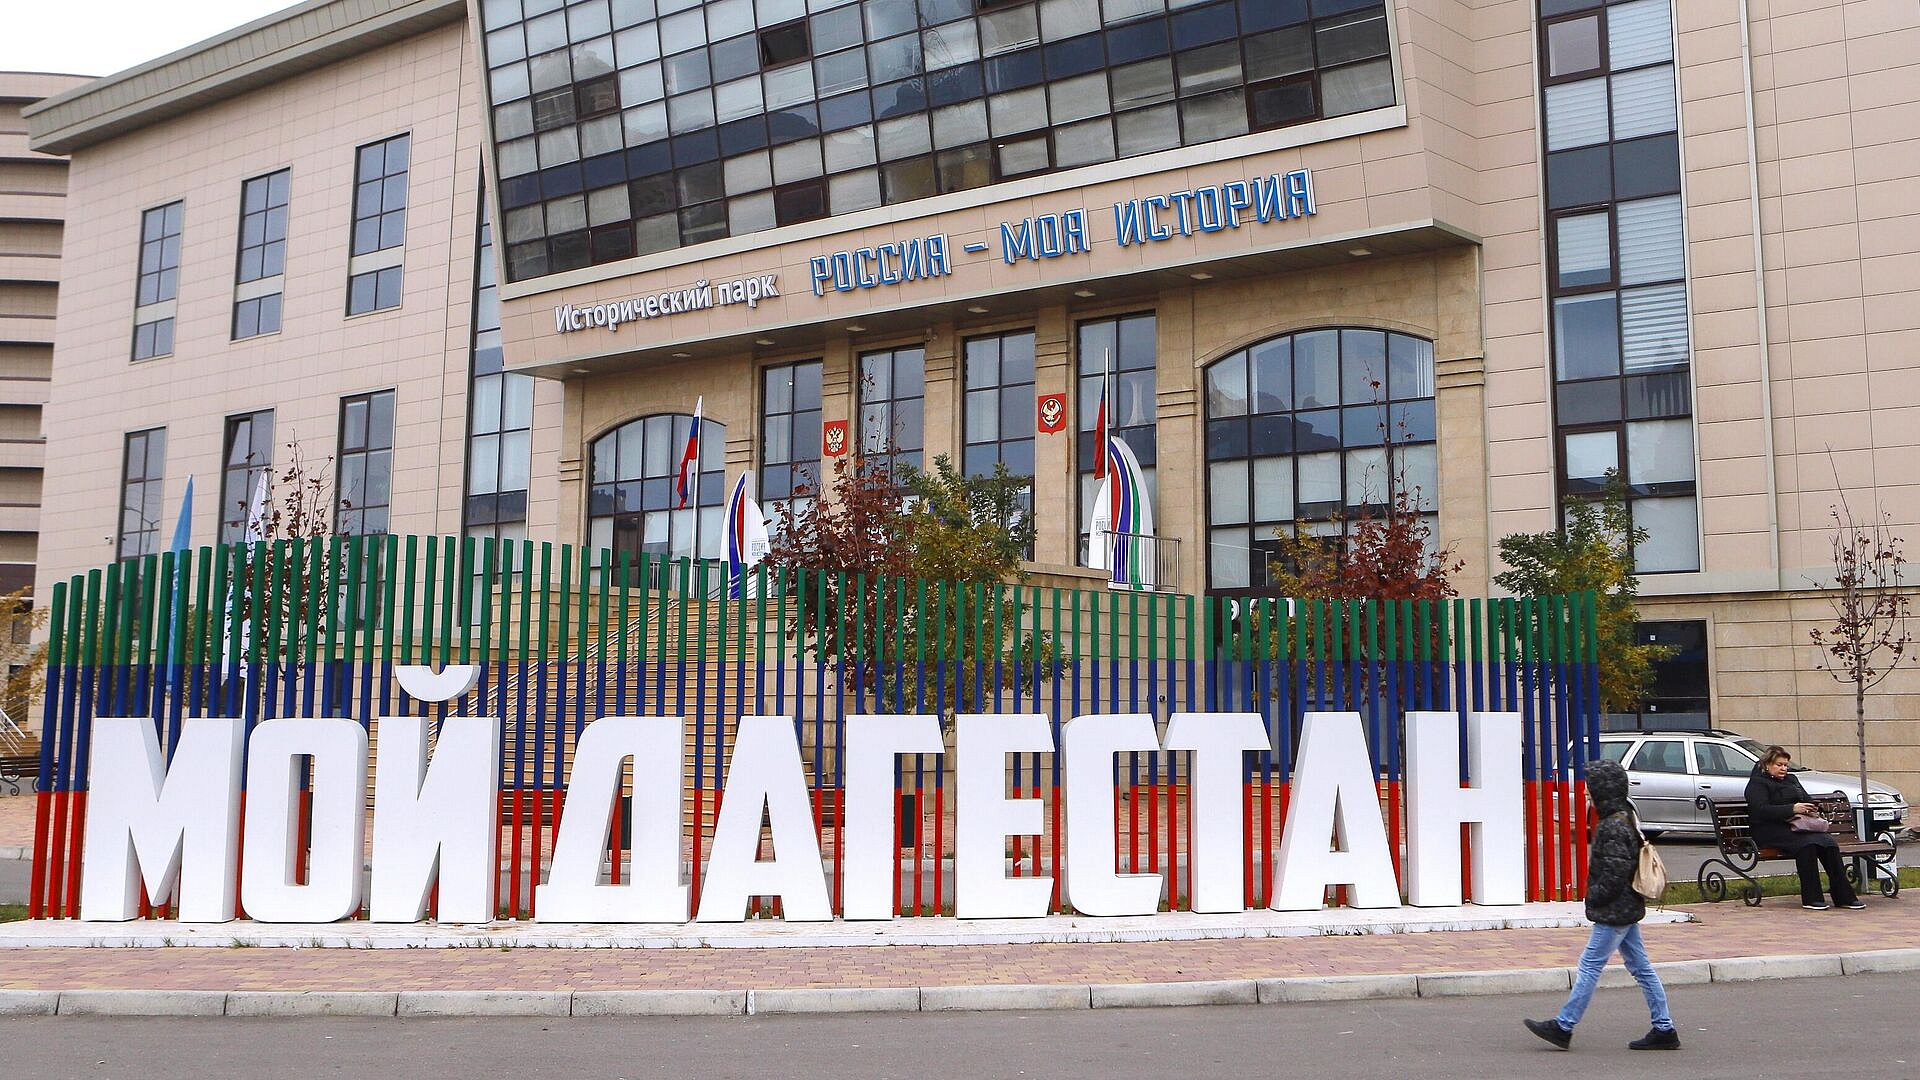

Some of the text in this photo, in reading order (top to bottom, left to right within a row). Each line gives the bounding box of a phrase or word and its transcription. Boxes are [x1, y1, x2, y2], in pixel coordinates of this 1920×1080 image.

[555, 280, 714, 333] Исторический
[718, 274, 780, 308] парк
[810, 233, 952, 296] РОССИЯ
[1001, 207, 1091, 266] МОЯ
[1113, 167, 1317, 248] ИСТОРИЯ
[81, 664, 1526, 924] МОЙ ДАГЕСТАН
